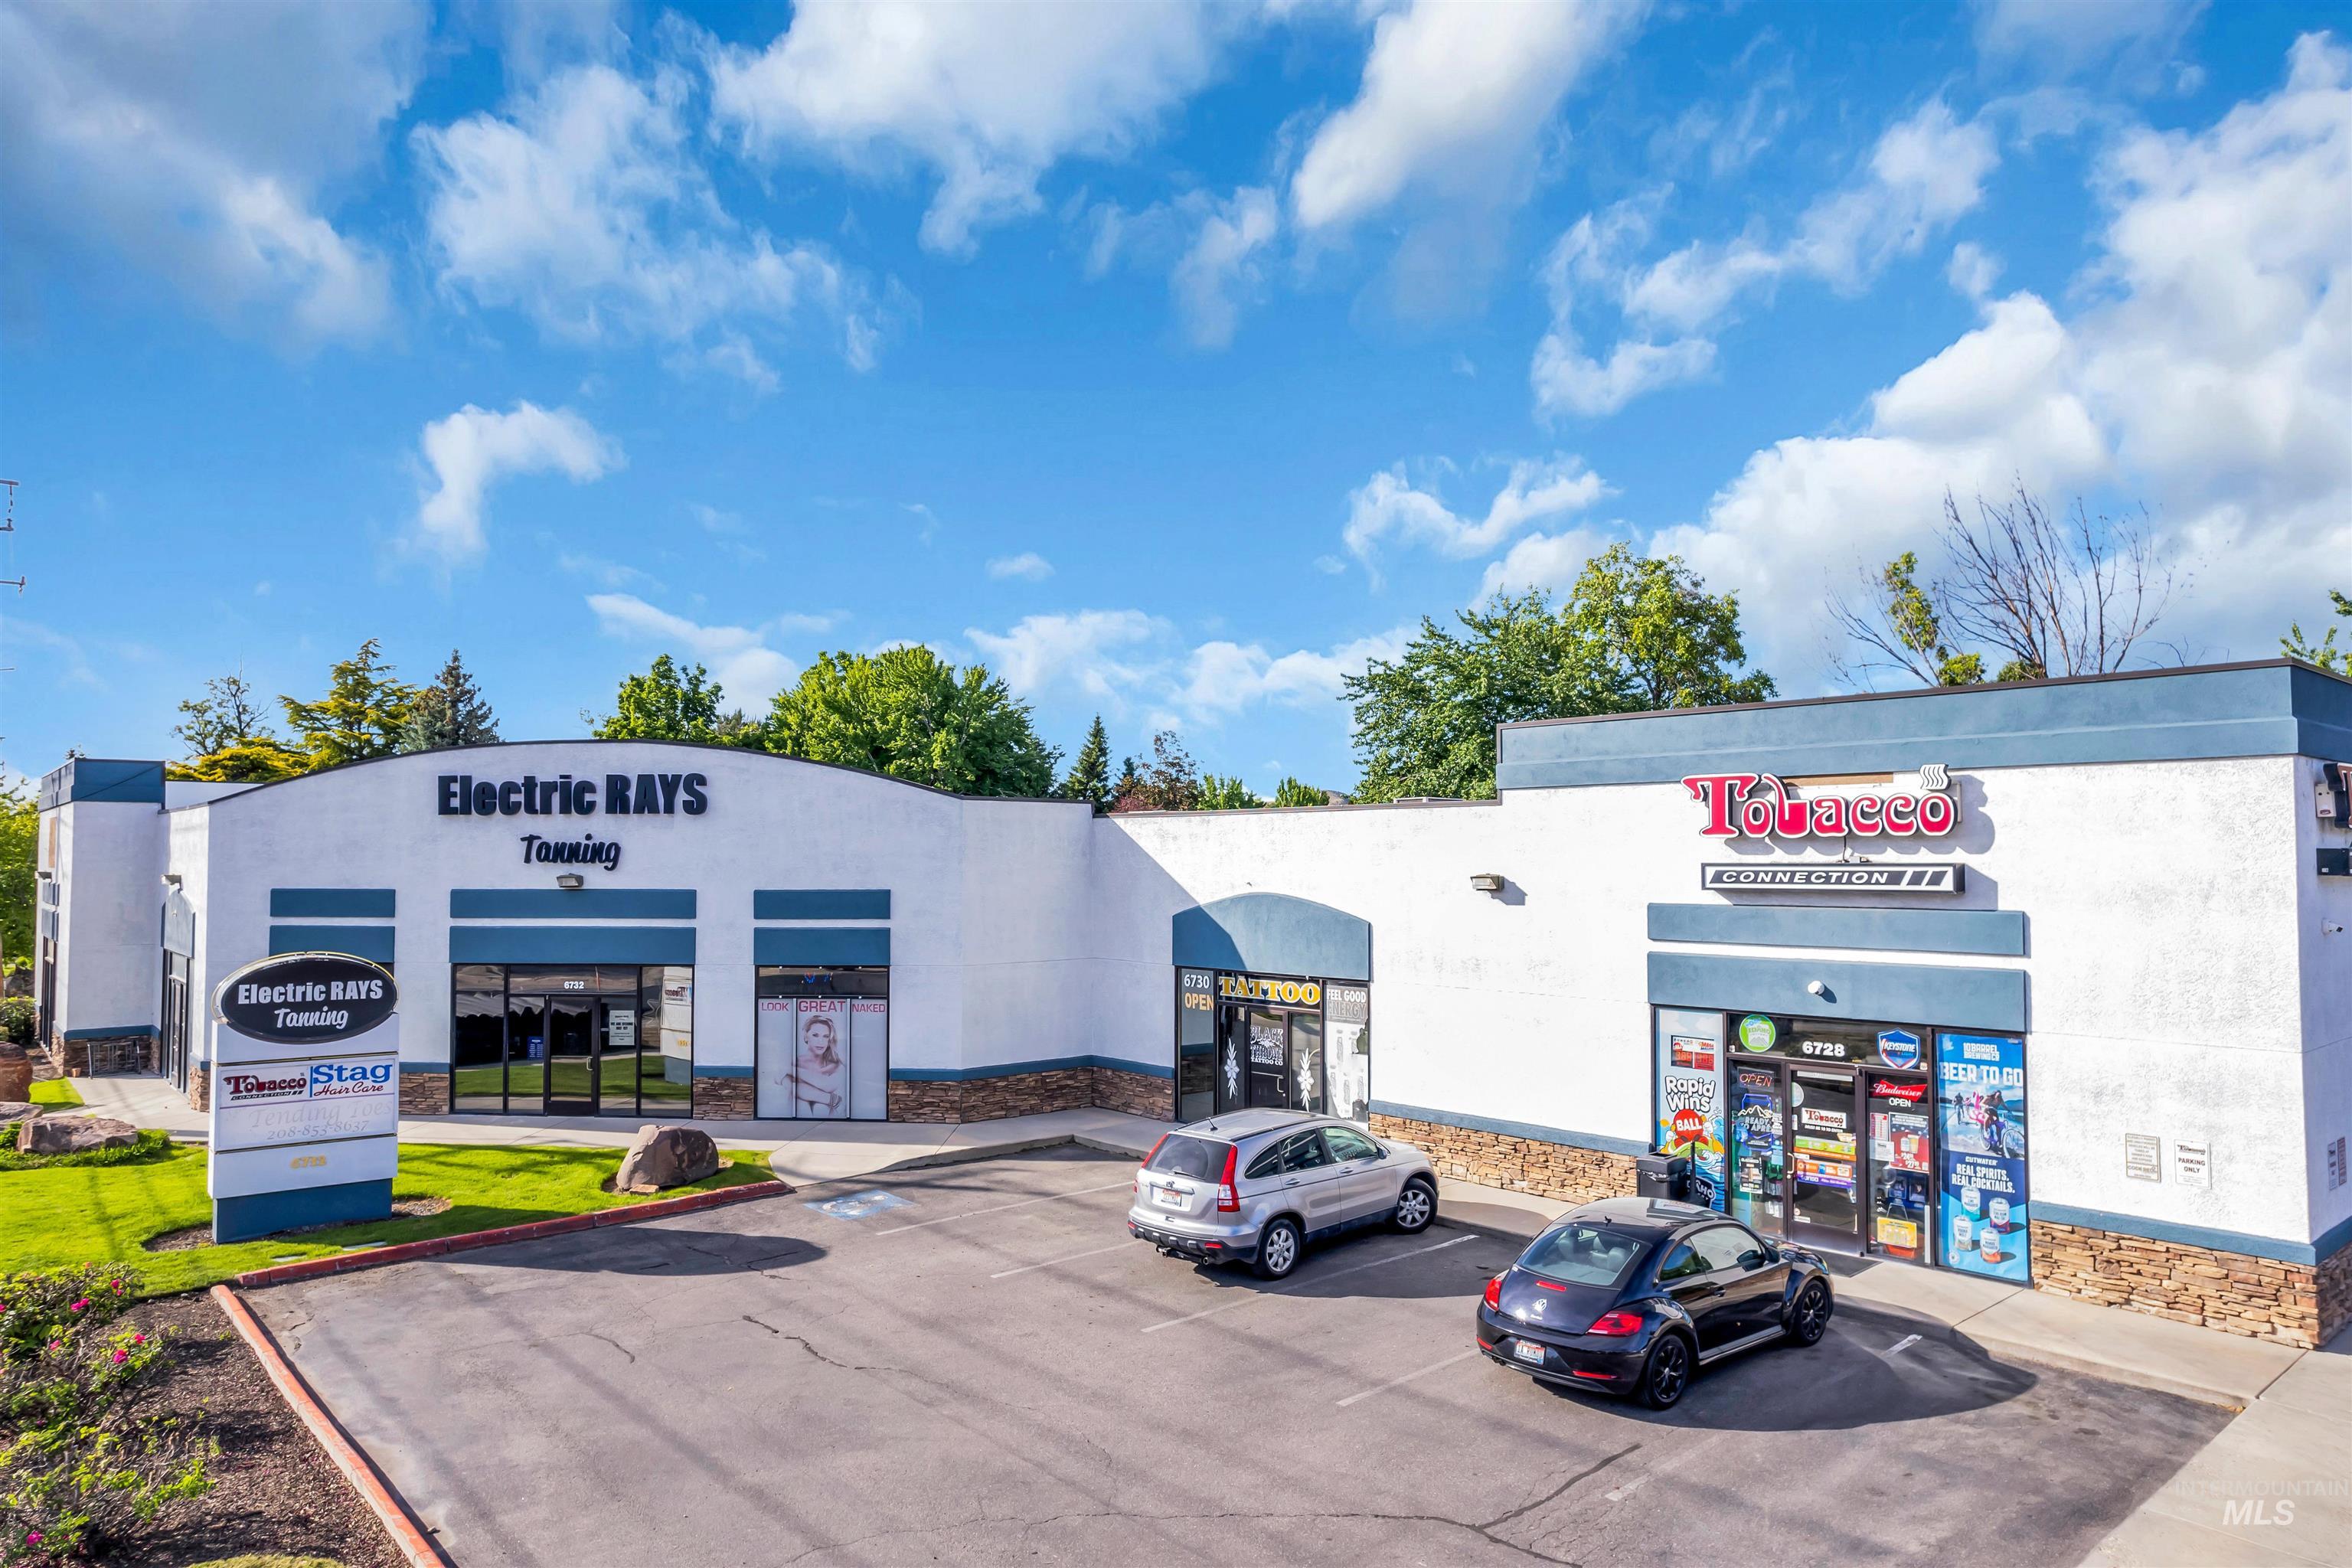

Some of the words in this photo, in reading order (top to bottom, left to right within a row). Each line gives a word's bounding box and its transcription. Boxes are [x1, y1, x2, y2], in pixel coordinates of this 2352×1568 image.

[438, 774, 597, 816] Electric
[605, 773, 708, 815] RAYS
[1680, 773, 1957, 838] Tobacco
[520, 833, 622, 871] Tanning
[1722, 871, 1890, 885] CONNECTION
[564, 981, 585, 990] 6732
[1184, 974, 1210, 989] 6730
[237, 982, 327, 1004] Electric
[330, 979, 384, 1001] RAYS
[1219, 976, 1321, 1005] TATTOO
[1327, 988, 1343, 1001] FEEL
[1344, 989, 1367, 1003] GOOD
[761, 1001, 789, 1012] LOOK
[798, 1000, 847, 1013] GREAT
[851, 1003, 886, 1013] NAKED
[1184, 992, 1214, 1011] OPEN
[1328, 1000, 1367, 1019] ENERGY
[274, 1005, 349, 1030] Tanning
[1802, 1040, 1845, 1057] 6728
[1885, 1040, 1916, 1053] KEYSTONE
[1971, 1043, 1998, 1054] BARREL
[313, 1064, 394, 1085] Stag
[1739, 1073, 1773, 1087] OPEN
[1939, 1062, 1978, 1083] BEER
[1979, 1065, 2000, 1085] TO
[2003, 1067, 2024, 1086] GO
[223, 1074, 307, 1096] Tobacco
[313, 1084, 350, 1096] Hair
[351, 1081, 384, 1093] Care
[1664, 1075, 1717, 1099] Rapid
[1873, 1083, 1922, 1097] Budweiser
[231, 1091, 292, 1100] CONNECTION
[1666, 1093, 1711, 1113] Wins
[1888, 1097, 1912, 1108] OPEN
[249, 1102, 341, 1128] Tending
[347, 1099, 394, 1119] Toes
[1745, 1116, 1769, 1125] READY
[1676, 1118, 1703, 1132] BALL
[1965, 1156, 1998, 1166] CUTWATER
[2177, 1157, 2206, 1166] PARKING
[1956, 1164, 1975, 1177] REAL
[1976, 1166, 2010, 1181] SPIRITS.
[2184, 1165, 2200, 1174] ONLY
[1952, 1174, 1971, 1187] REAL
[1971, 1176, 2016, 1194] COCKTAILS.
